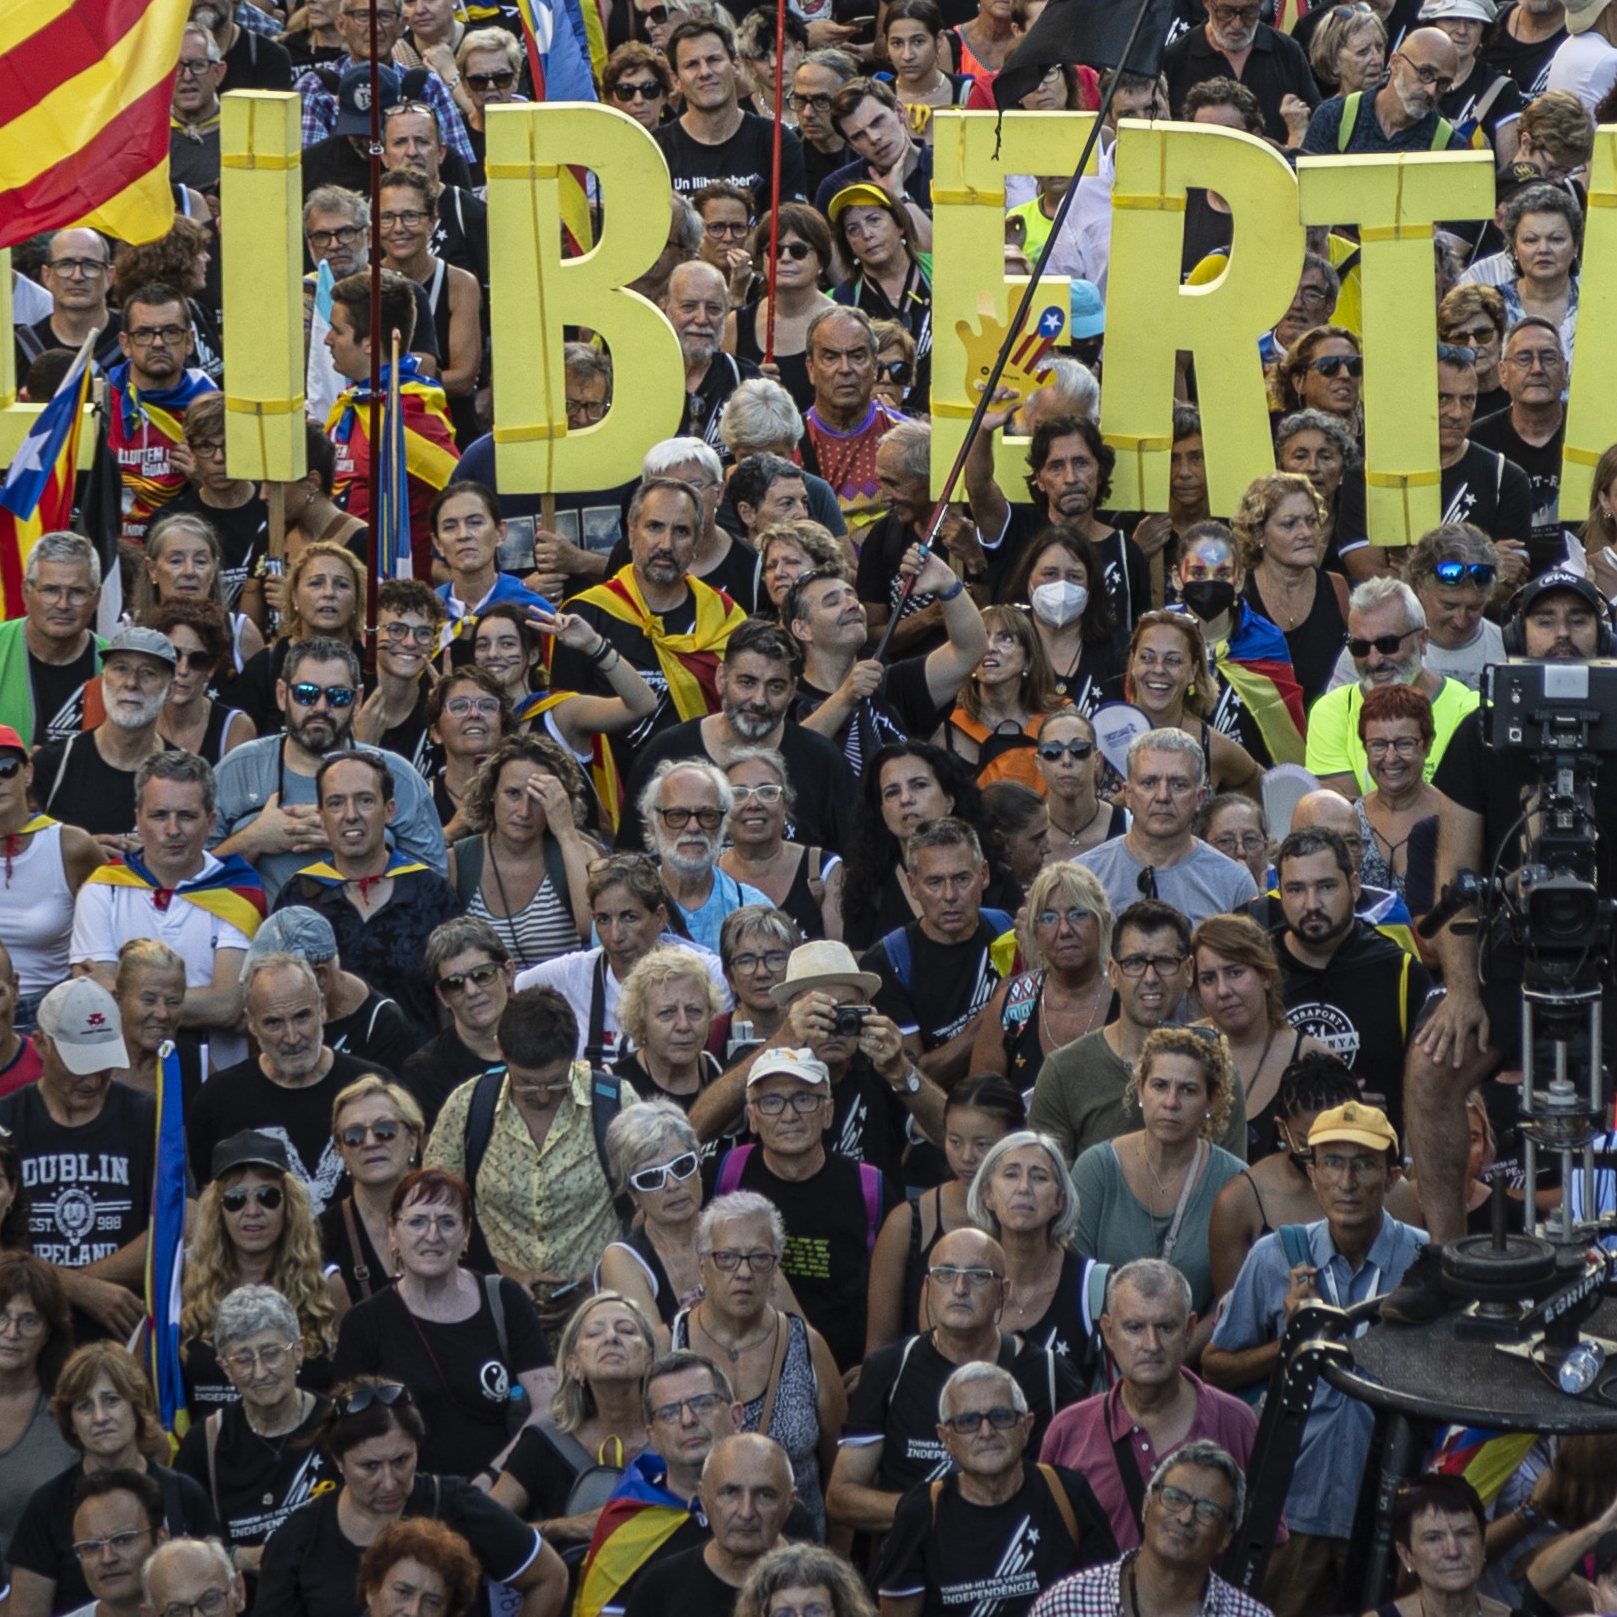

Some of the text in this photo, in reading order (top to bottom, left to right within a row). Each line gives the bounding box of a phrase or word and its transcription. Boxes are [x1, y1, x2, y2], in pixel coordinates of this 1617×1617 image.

[674, 177, 690, 190] Un
[118, 446, 164, 464] LLUITEM
[22, 1154, 129, 1187] DUBLIN
[940, 1570, 1037, 1593] TORNEM-HI PER VÈNCER
[942, 1578, 1040, 1604] INDEPENDÈNCIA
